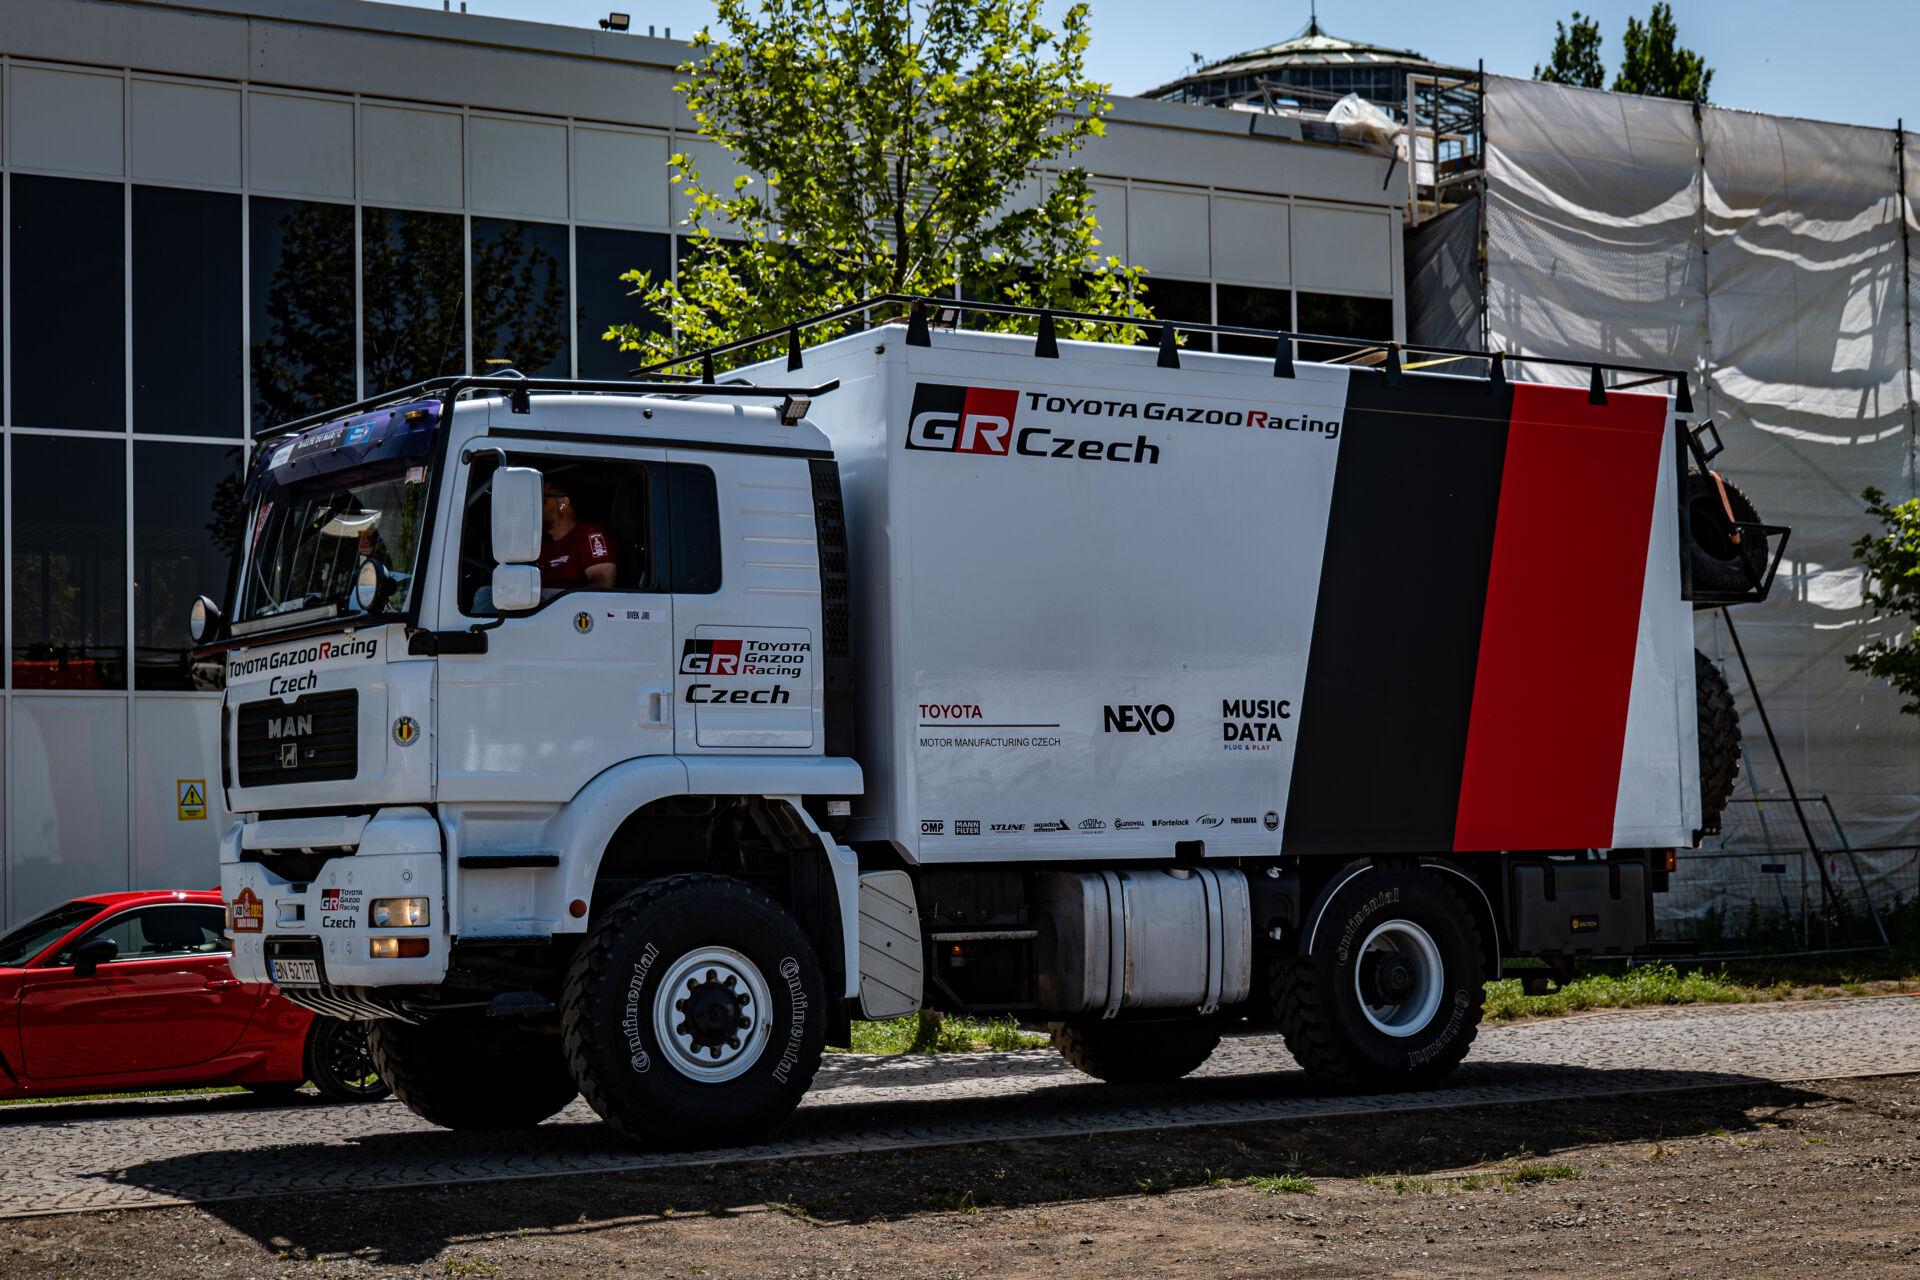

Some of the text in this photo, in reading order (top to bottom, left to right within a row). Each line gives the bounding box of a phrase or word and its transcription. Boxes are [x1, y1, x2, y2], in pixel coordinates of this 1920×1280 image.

[1025, 392, 1340, 439] TOYOTA GAZOO Racing
[909, 411, 1009, 452] GR
[1015, 426, 1160, 464] Czech
[746, 640, 811, 652] TOYOTA
[229, 639, 377, 678] TOYOTA GAZOO Racing
[681, 653, 738, 674] GR
[744, 652, 804, 664] GAZOO
[742, 664, 801, 678] Racing
[269, 670, 317, 696] Czech
[685, 683, 790, 704] Czech
[919, 704, 983, 719] TOYOTA
[1222, 699, 1291, 719] MUSIC
[268, 714, 313, 739] MAN
[1103, 704, 1175, 735] NEXO
[1223, 722, 1282, 742] DATA
[919, 737, 1061, 748] MOTOR MANUFACTURING CZECH
[920, 822, 944, 832] OMP
[989, 823, 1026, 831] XTLINE
[1033, 821, 1060, 829] agados
[321, 897, 339, 910] GR
[339, 904, 360, 912] Racing
[322, 915, 356, 928] Czech
[275, 962, 289, 979] BN
[622, 942, 660, 1073] Continental
[772, 957, 808, 1084] Continental
